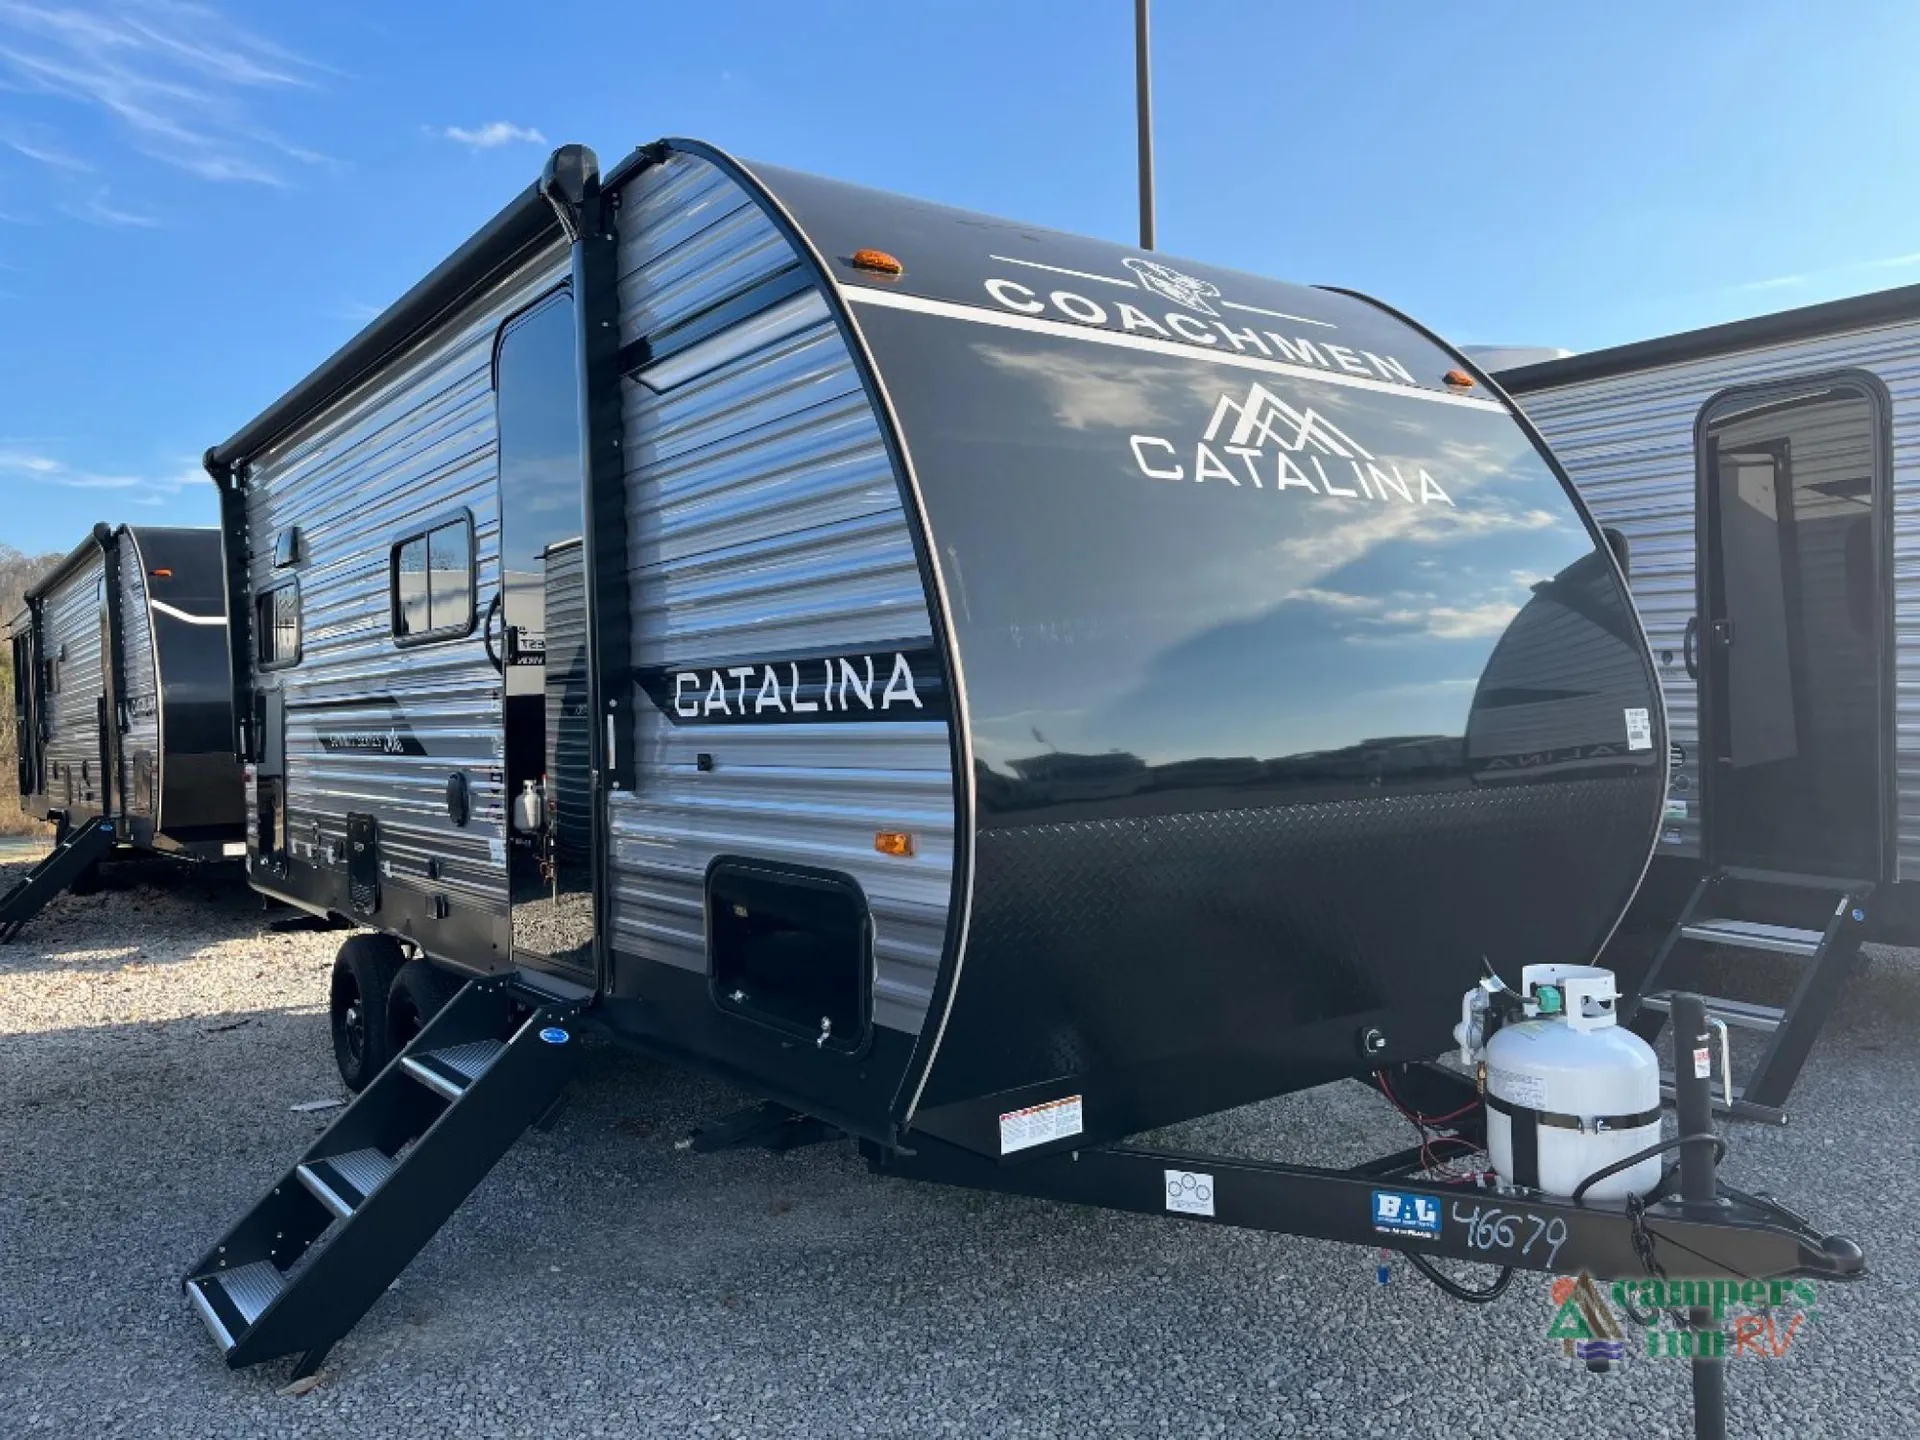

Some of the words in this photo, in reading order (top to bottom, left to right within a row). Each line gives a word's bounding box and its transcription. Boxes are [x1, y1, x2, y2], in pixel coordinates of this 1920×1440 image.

[984, 277, 1418, 385] COACHMEN
[1130, 434, 1455, 507] CATALINA
[674, 652, 923, 718] CATALINA
[1452, 1201, 1567, 1269] 46679
